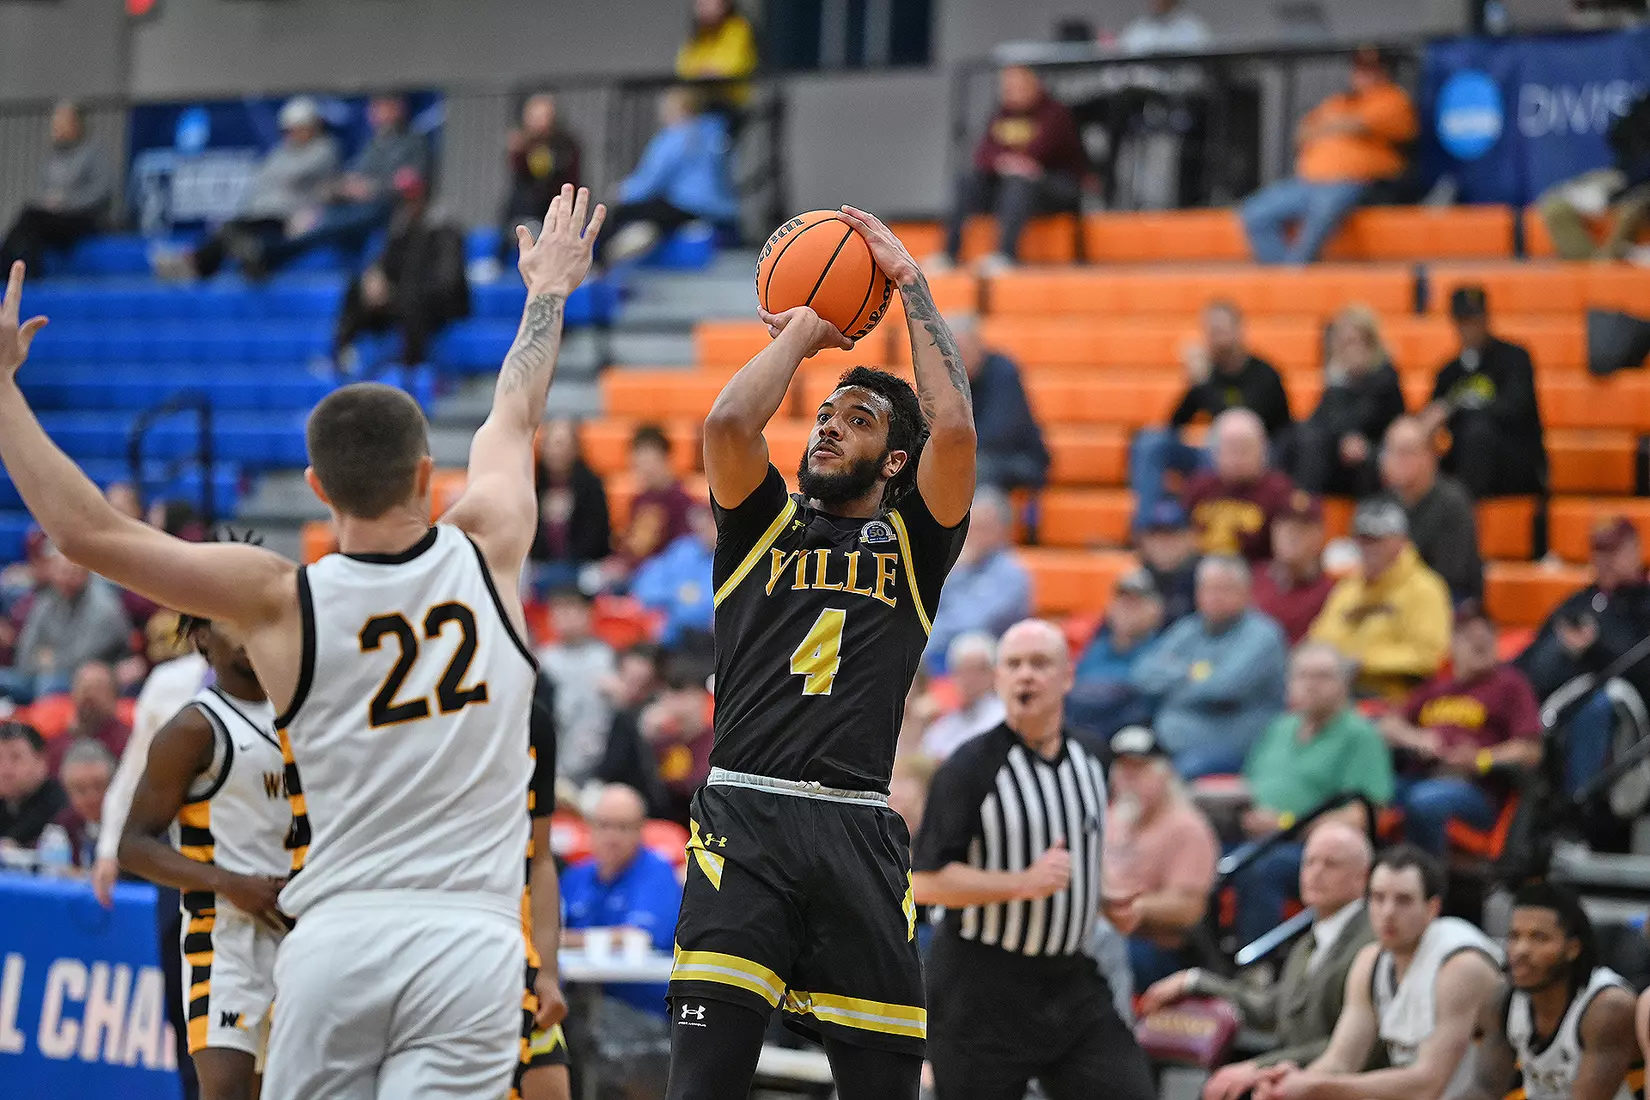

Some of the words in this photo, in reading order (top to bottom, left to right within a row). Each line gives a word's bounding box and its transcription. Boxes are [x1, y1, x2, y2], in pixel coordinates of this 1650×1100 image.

[869, 528, 886, 538] 50
[765, 547, 899, 609] VILLE
[357, 600, 489, 730] 22
[790, 607, 847, 696] 4
